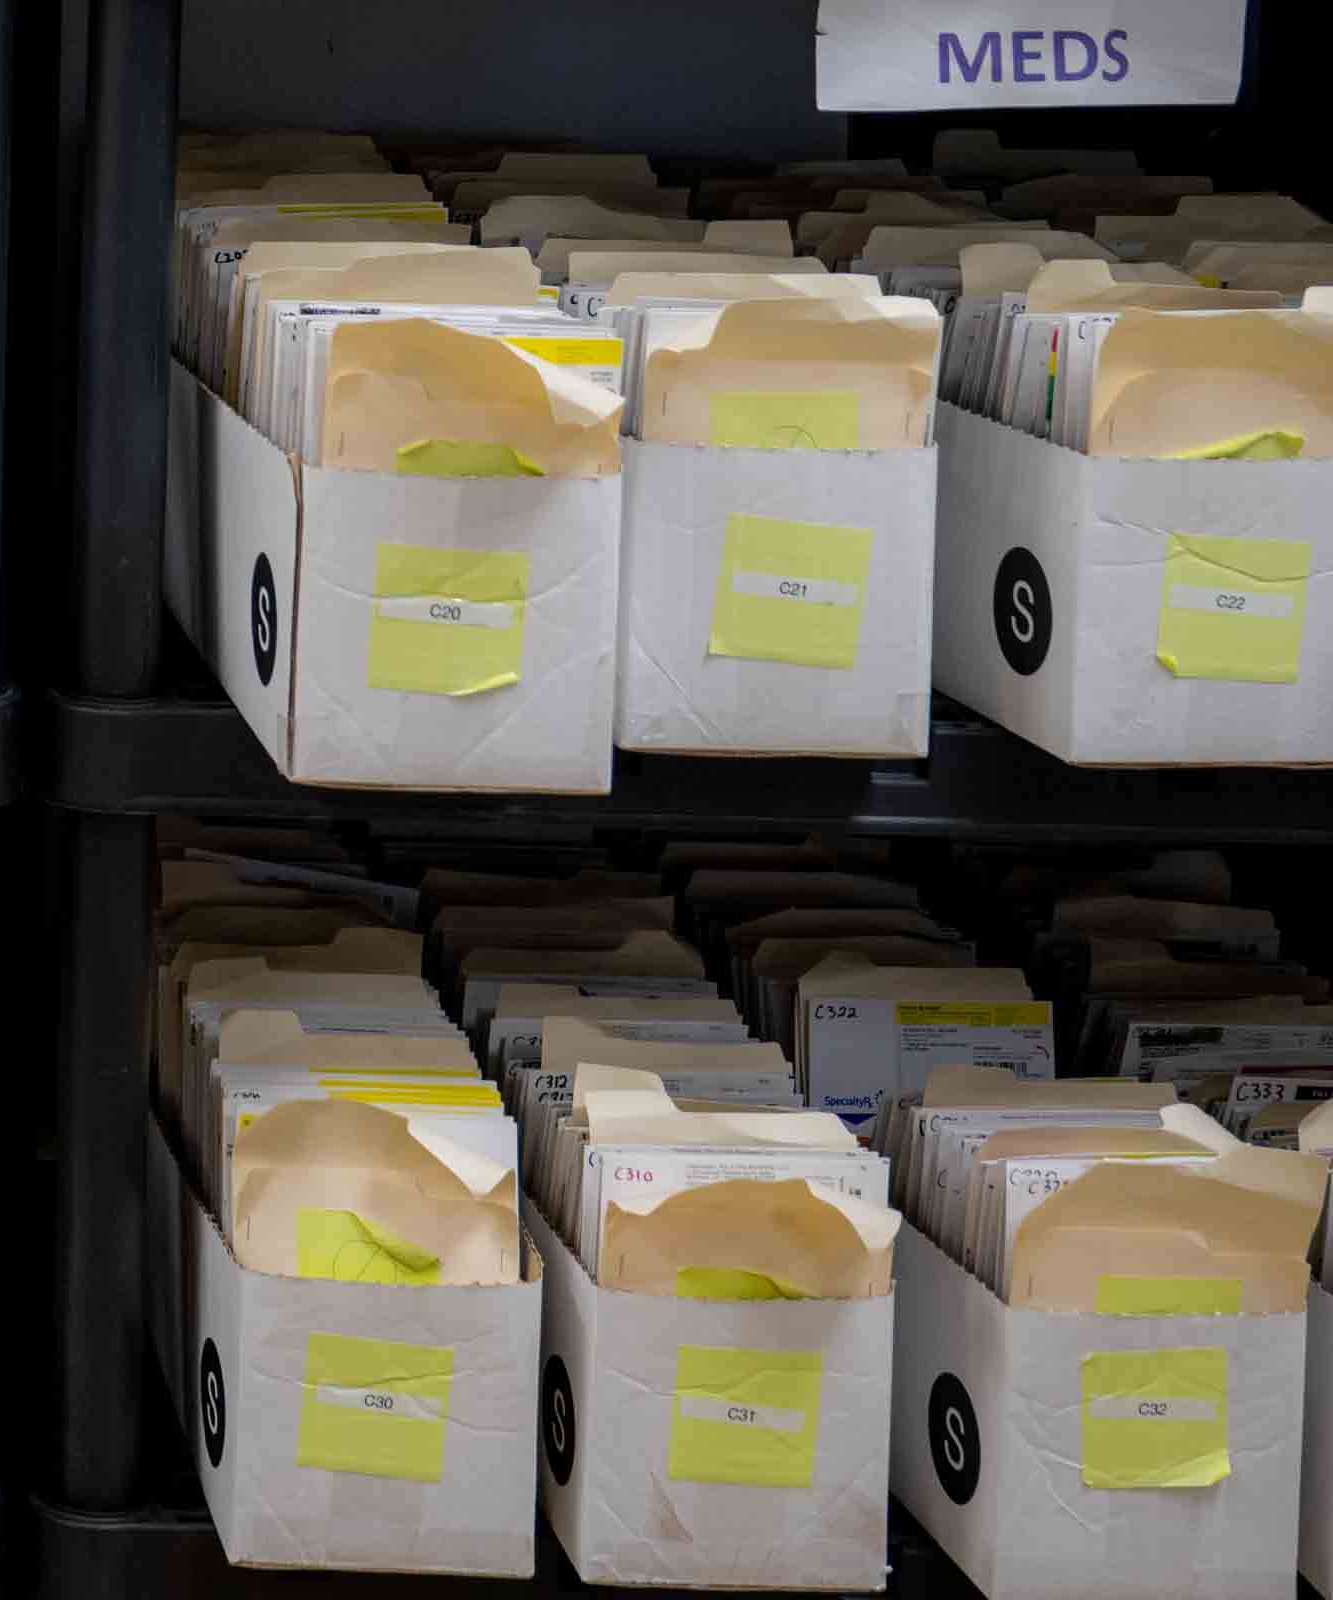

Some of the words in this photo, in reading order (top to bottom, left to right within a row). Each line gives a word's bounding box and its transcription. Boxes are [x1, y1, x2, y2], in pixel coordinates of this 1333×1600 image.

[937, 29, 1130, 84] MEDS
[779, 582, 807, 597] C21
[1215, 594, 1246, 610] C22
[258, 586, 270, 652] S
[430, 604, 461, 621] C20
[1010, 579, 1034, 643] S
[815, 1004, 858, 1019] C322
[1236, 1082, 1285, 1101] C333
[614, 1167, 654, 1182] C310
[207, 1371, 218, 1435] S
[364, 1394, 394, 1410] C30
[1138, 1402, 1168, 1416] C32
[553, 1388, 566, 1453] S
[727, 1407, 756, 1423] C31
[943, 1407, 965, 1472] S
